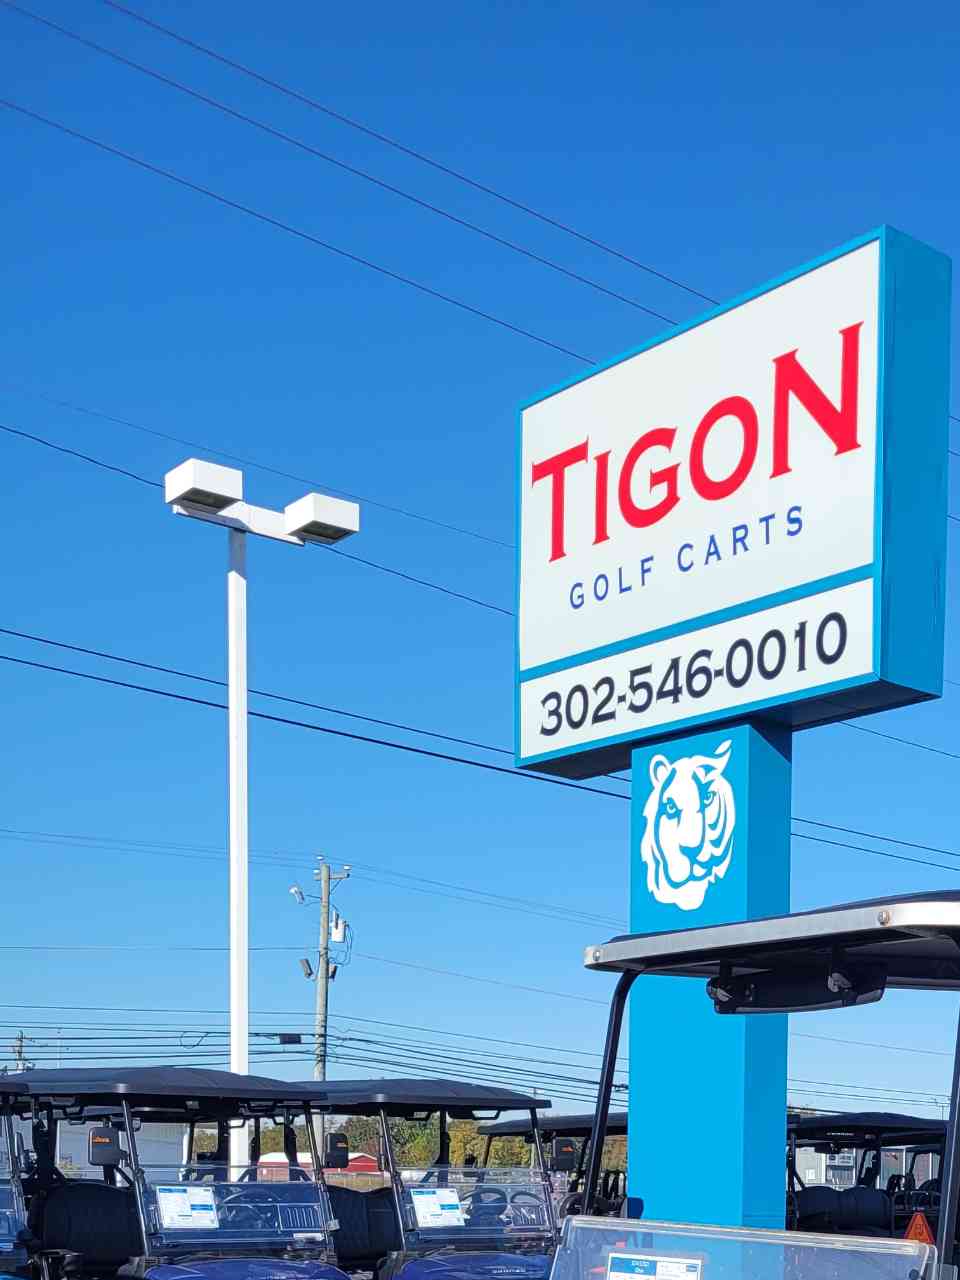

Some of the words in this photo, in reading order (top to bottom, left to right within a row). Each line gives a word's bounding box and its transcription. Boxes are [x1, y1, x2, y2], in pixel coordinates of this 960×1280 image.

[531, 321, 864, 562] TIGON
[569, 556, 654, 609] GOLF
[677, 505, 804, 573] CARTS
[539, 611, 848, 736] 302-546-0010
